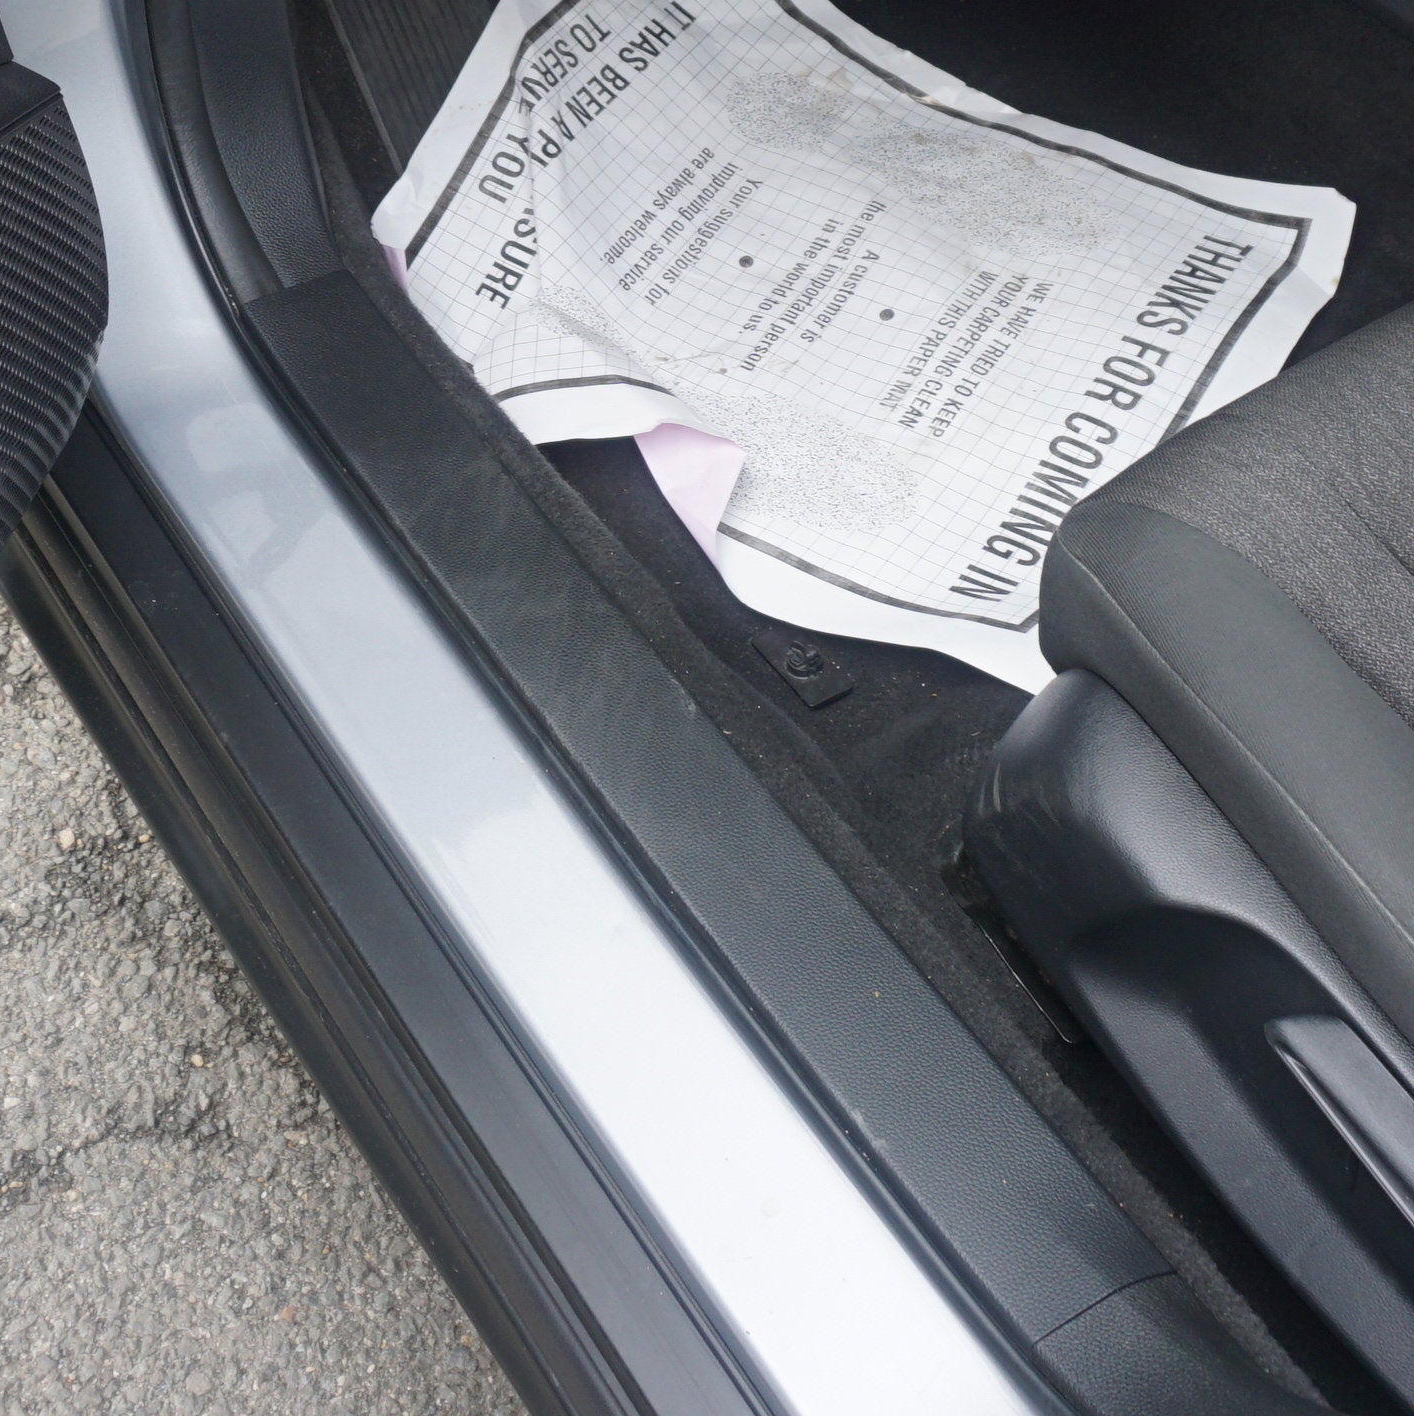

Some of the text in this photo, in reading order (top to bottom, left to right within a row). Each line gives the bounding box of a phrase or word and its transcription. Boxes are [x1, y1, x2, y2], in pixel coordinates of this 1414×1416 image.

[568, 13, 612, 54] TO
[475, 0, 698, 310] IT HAS BEEN A PSURE
[477, 132, 532, 204] YOU
[599, 146, 715, 265] are always welcome.
[618, 161, 744, 292] improving our service
[644, 178, 764, 307] Your suggestions for
[738, 217, 844, 335] in the world to us.
[740, 199, 888, 372] the most important person
[799, 248, 881, 344] A customer is
[878, 269, 1000, 413] WITH THIS PAPER MAT
[898, 274, 1030, 430] YOUR CARPETING CLEAN
[927, 282, 1055, 439] WE HAVE TRIED TO KEEP
[948, 234, 1255, 603] THANKS FOR COMING IN
